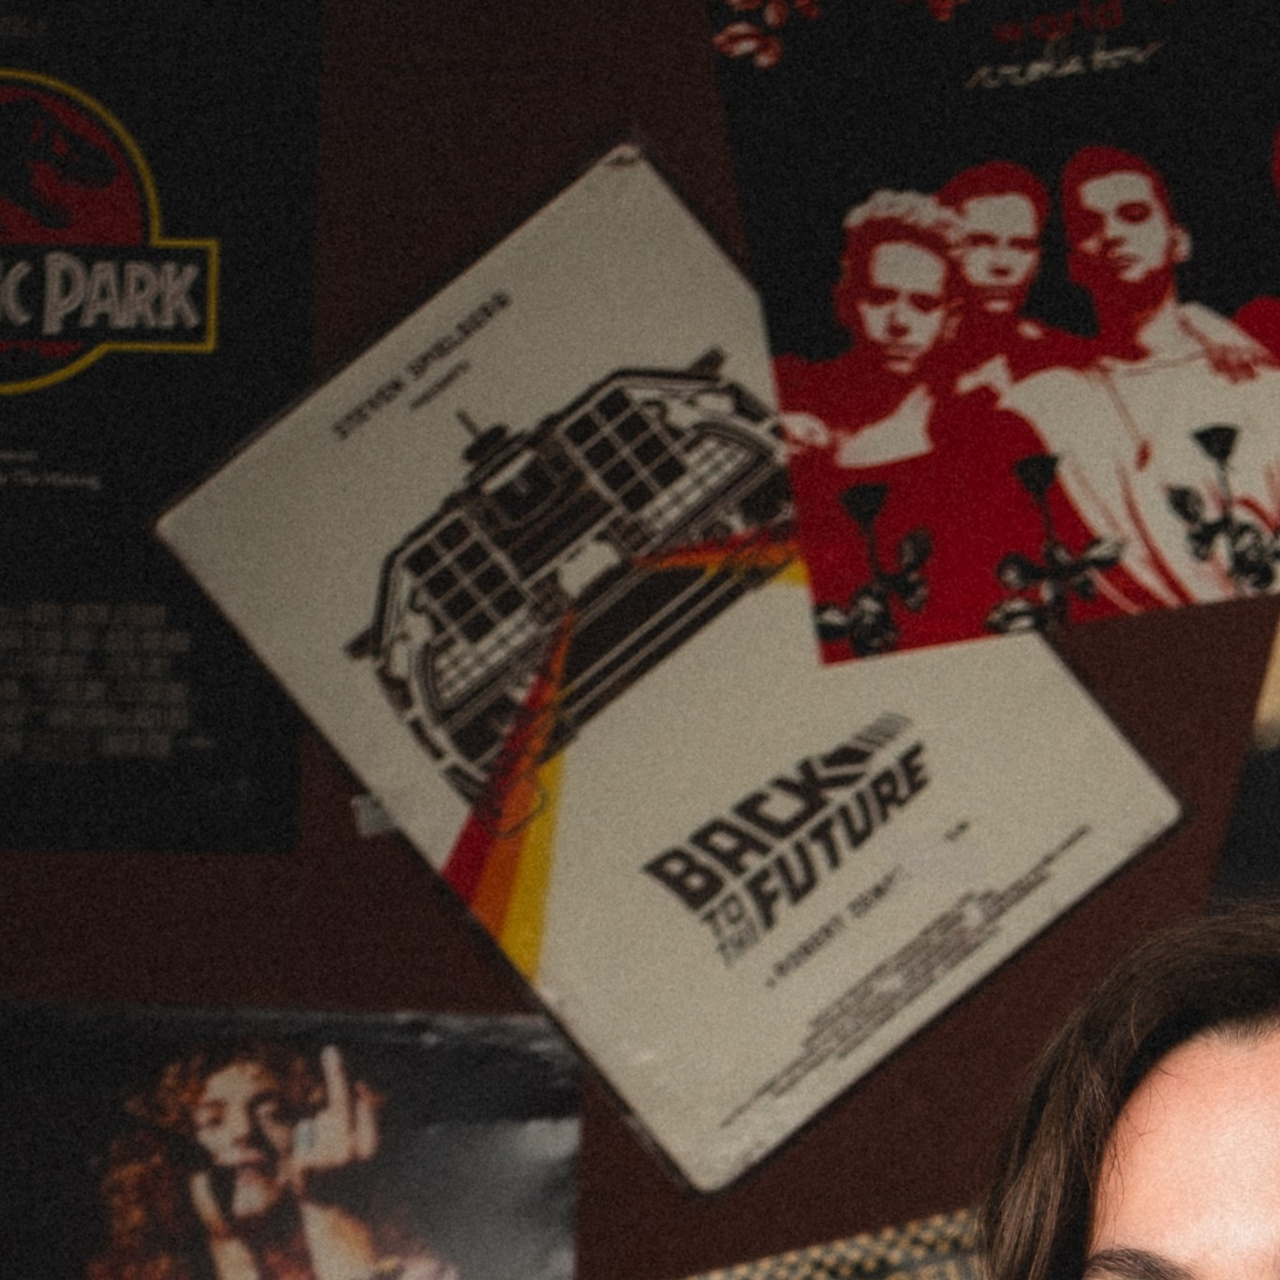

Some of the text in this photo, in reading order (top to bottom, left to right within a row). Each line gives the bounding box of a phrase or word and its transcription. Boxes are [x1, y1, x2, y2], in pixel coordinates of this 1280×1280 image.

[41, 250, 201, 336] PARK
[641, 720, 905, 912] BACK
[746, 740, 932, 933] FUTURE
[700, 897, 743, 936] TO
